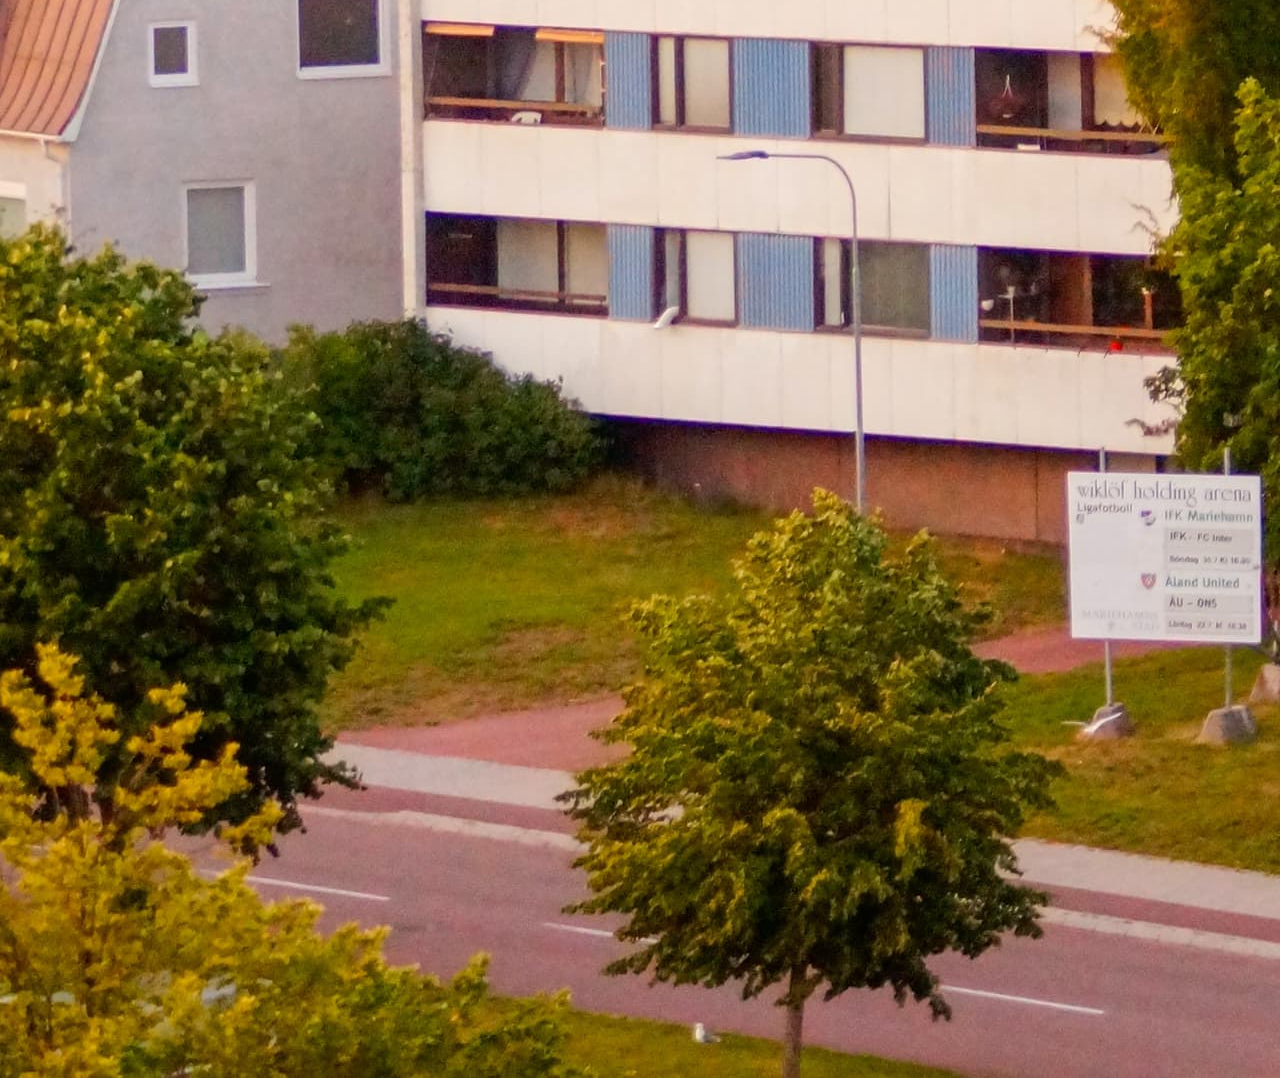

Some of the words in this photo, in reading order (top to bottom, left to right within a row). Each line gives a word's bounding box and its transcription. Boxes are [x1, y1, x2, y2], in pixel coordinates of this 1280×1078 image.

[1076, 480, 1126, 499] wiklöf
[1133, 480, 1197, 507] holding
[1204, 489, 1251, 502] arena
[1077, 503, 1133, 514] Ligafotboll
[1165, 510, 1182, 521] IFK
[1187, 510, 1254, 523] Mariehamn
[1165, 575, 1198, 587] Åland
[1203, 577, 1240, 588] United
